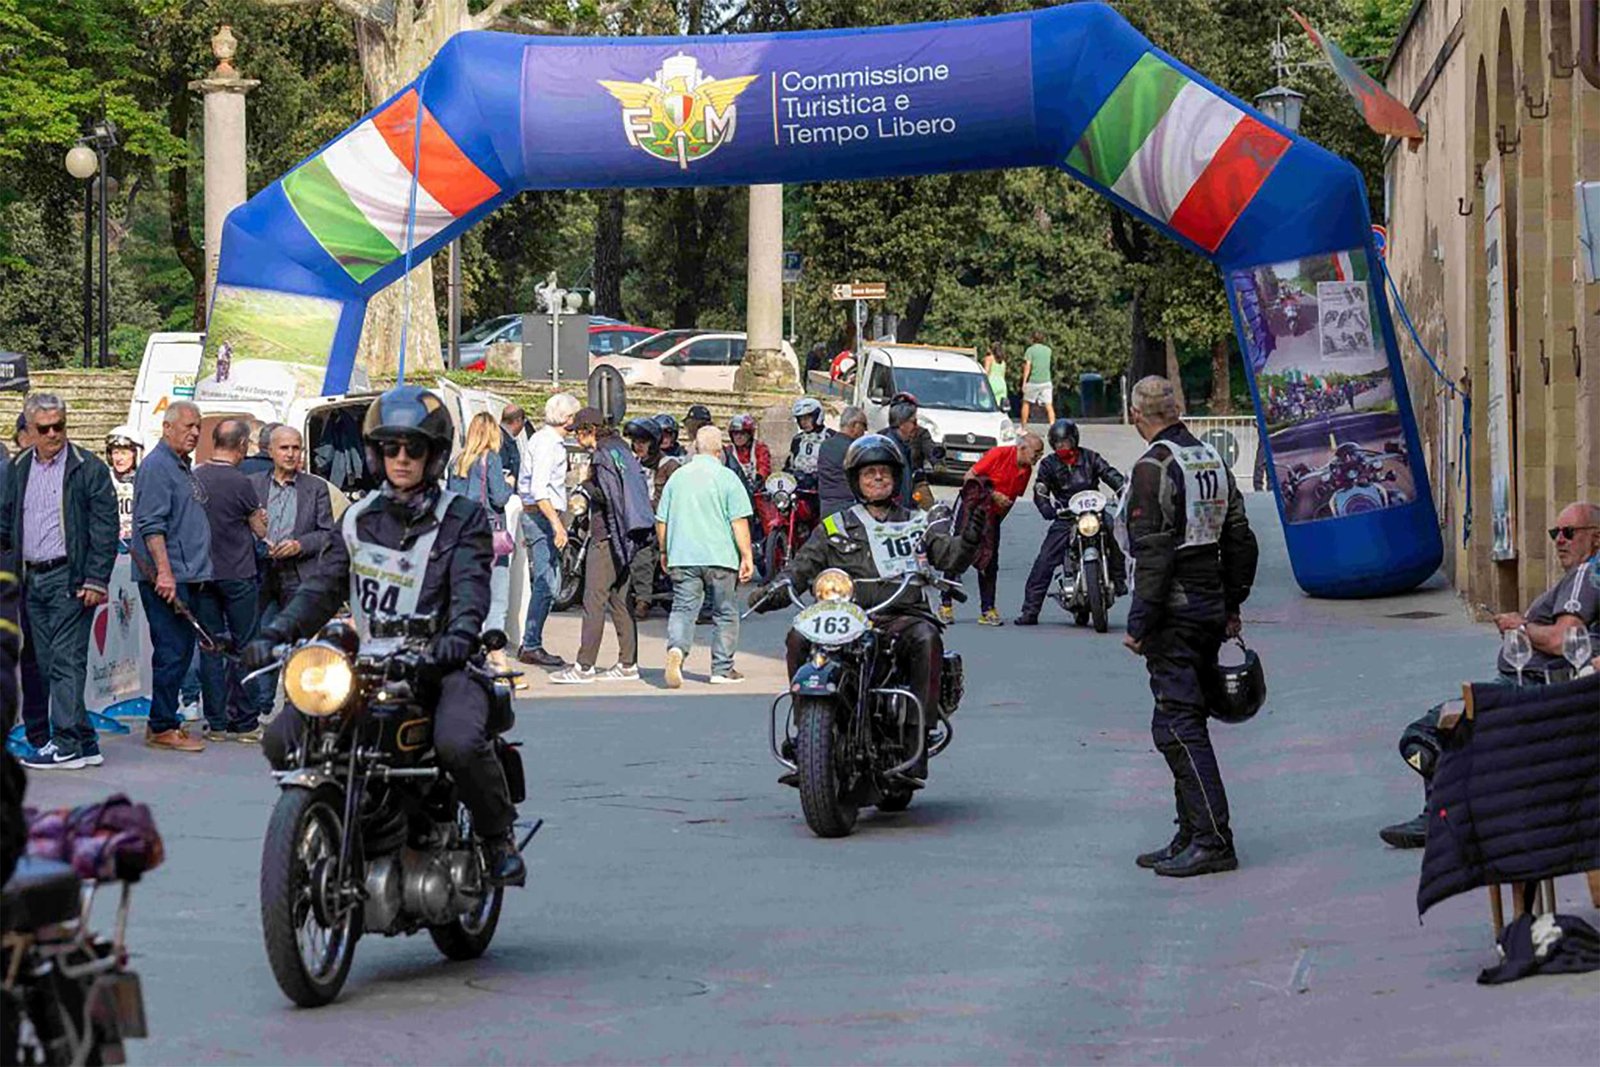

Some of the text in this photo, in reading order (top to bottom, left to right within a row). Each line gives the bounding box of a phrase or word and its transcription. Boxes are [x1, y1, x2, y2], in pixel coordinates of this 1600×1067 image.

[782, 64, 949, 91] Commissione
[781, 93, 910, 118] Turistica e
[782, 116, 956, 146] Tempo Libero
[805, 442, 814, 456] 6
[1194, 469, 1219, 500] 117
[1077, 498, 1098, 510] 162
[882, 530, 927, 559] 163
[812, 616, 851, 635] 163
